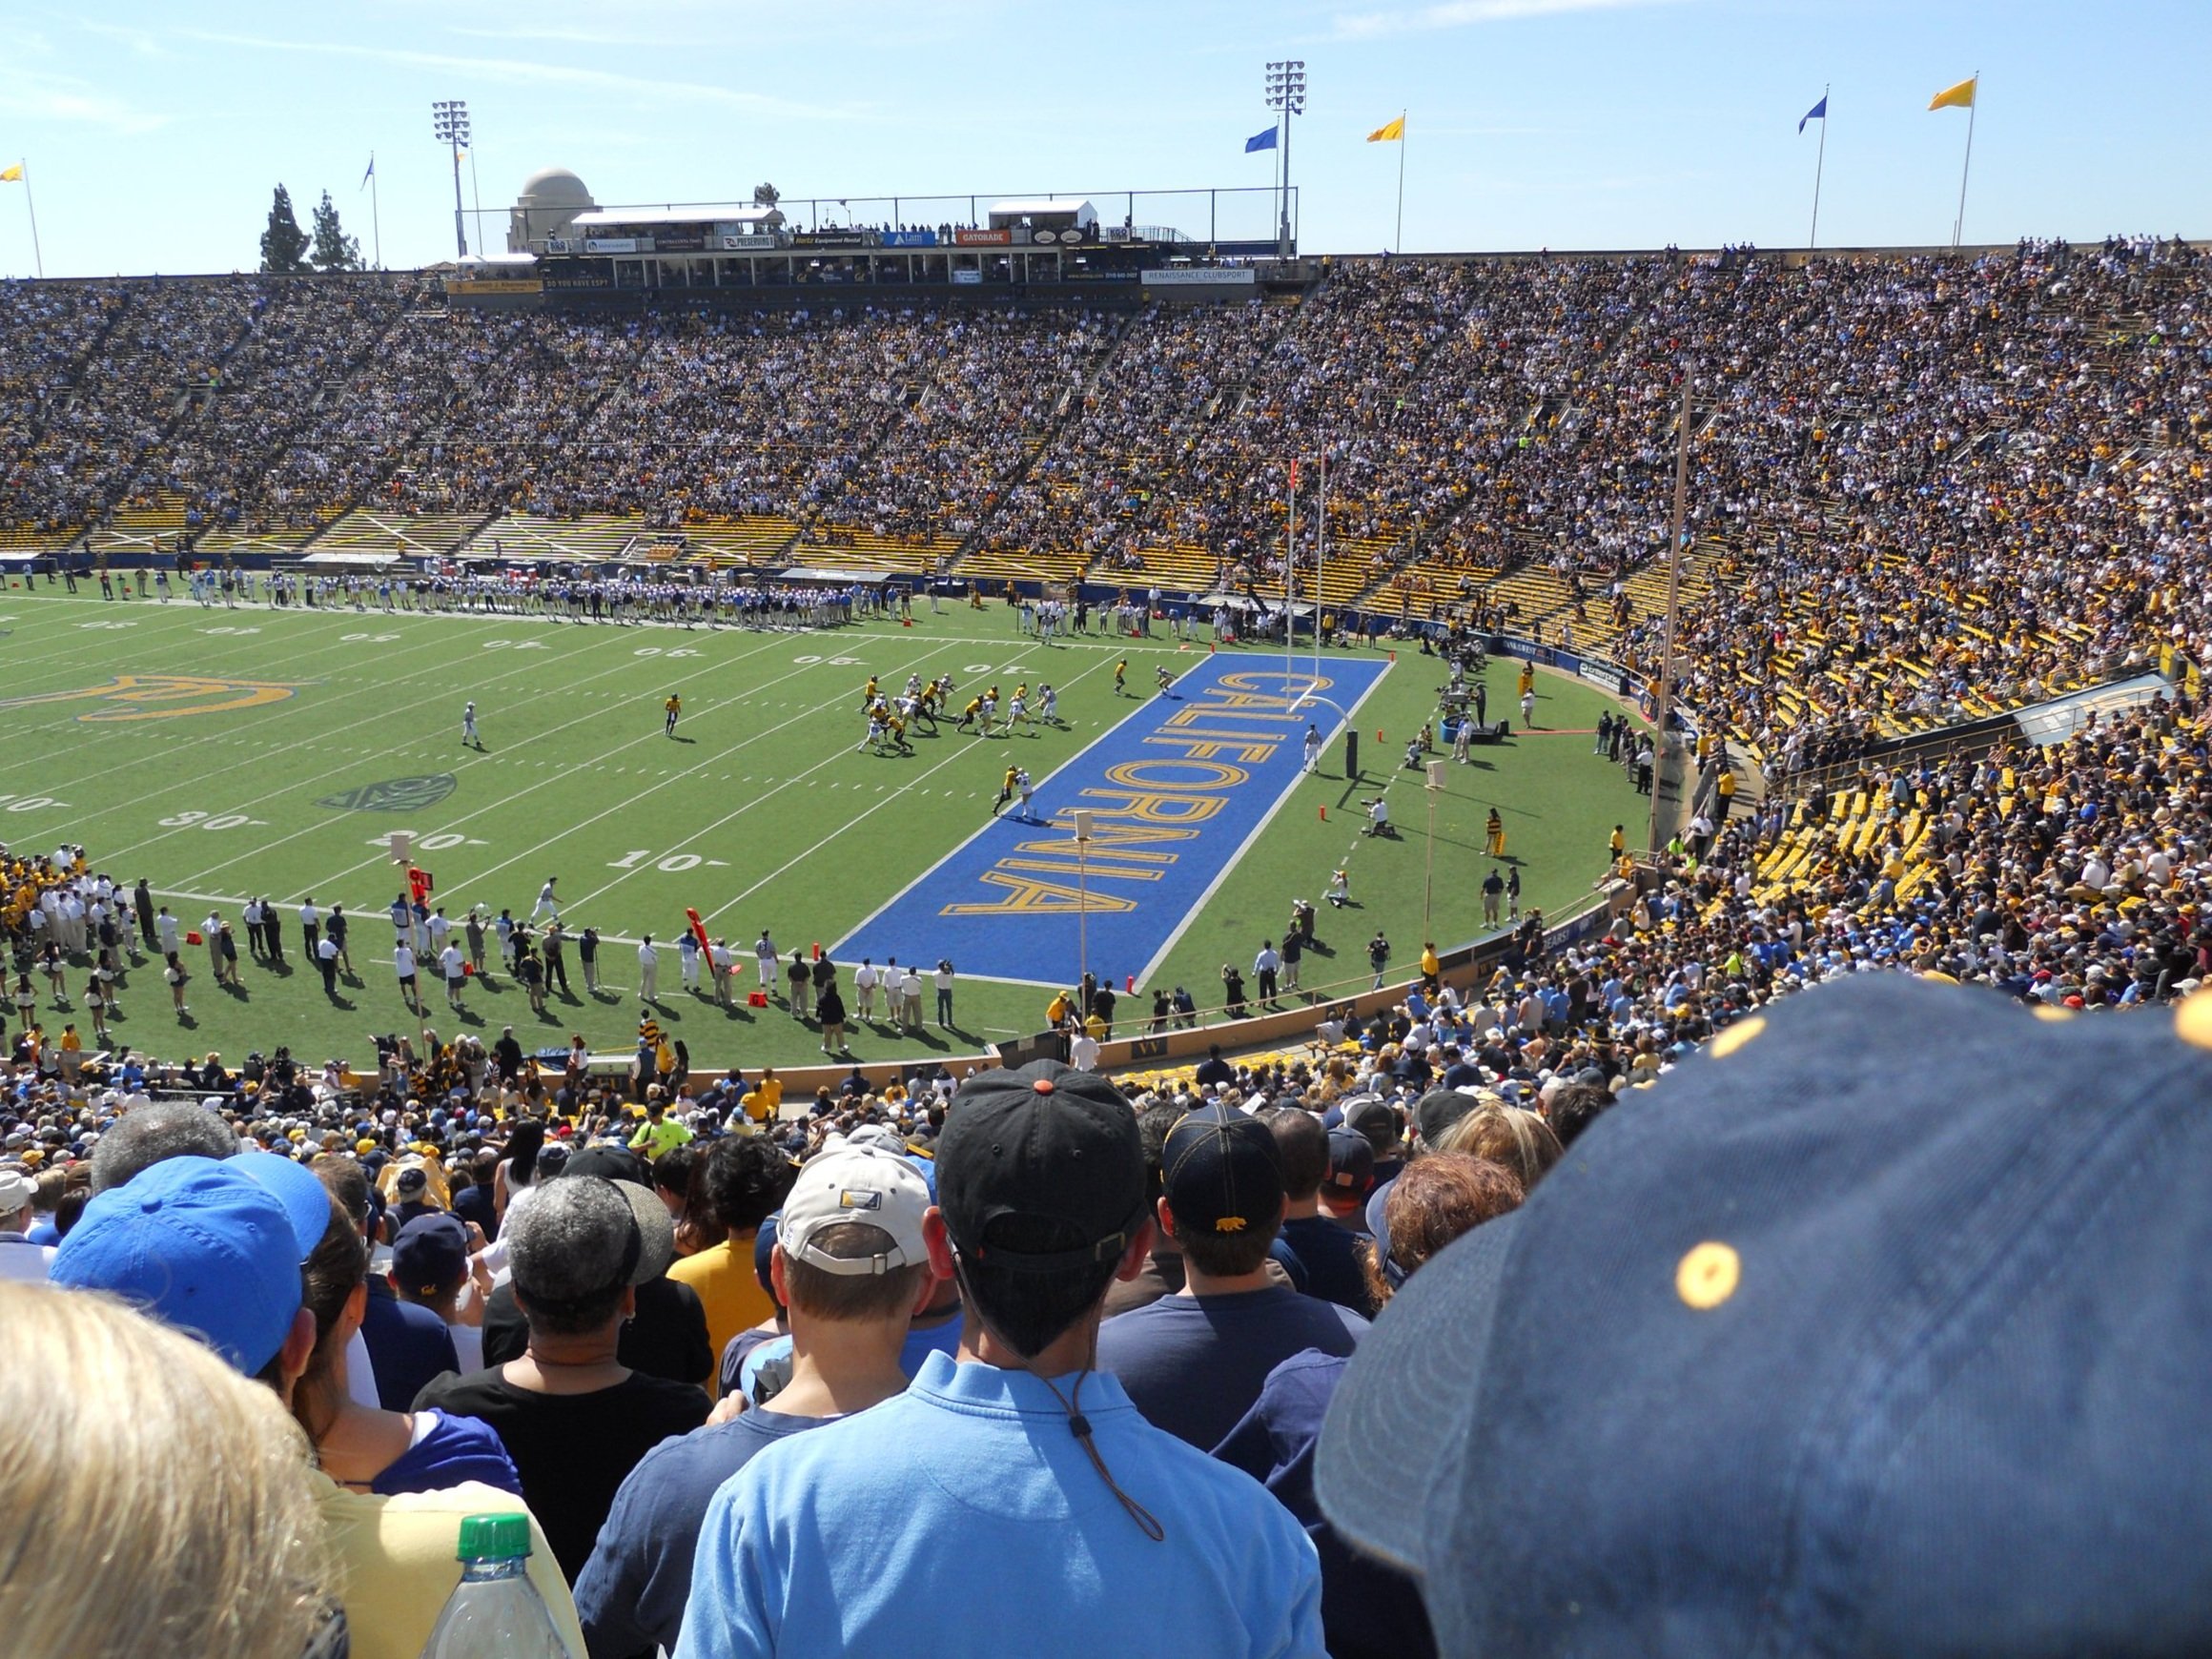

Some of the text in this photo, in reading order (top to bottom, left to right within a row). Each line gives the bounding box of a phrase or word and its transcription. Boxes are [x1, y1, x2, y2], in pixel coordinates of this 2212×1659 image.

[796, 233, 862, 243] Hertz Equipment Rental
[1149, 271, 1245, 279] RENAISSANCE CLUBSPORT
[939, 671, 1335, 916] CALIFORNIA
[157, 811, 250, 830] 30
[605, 850, 703, 871] 10
